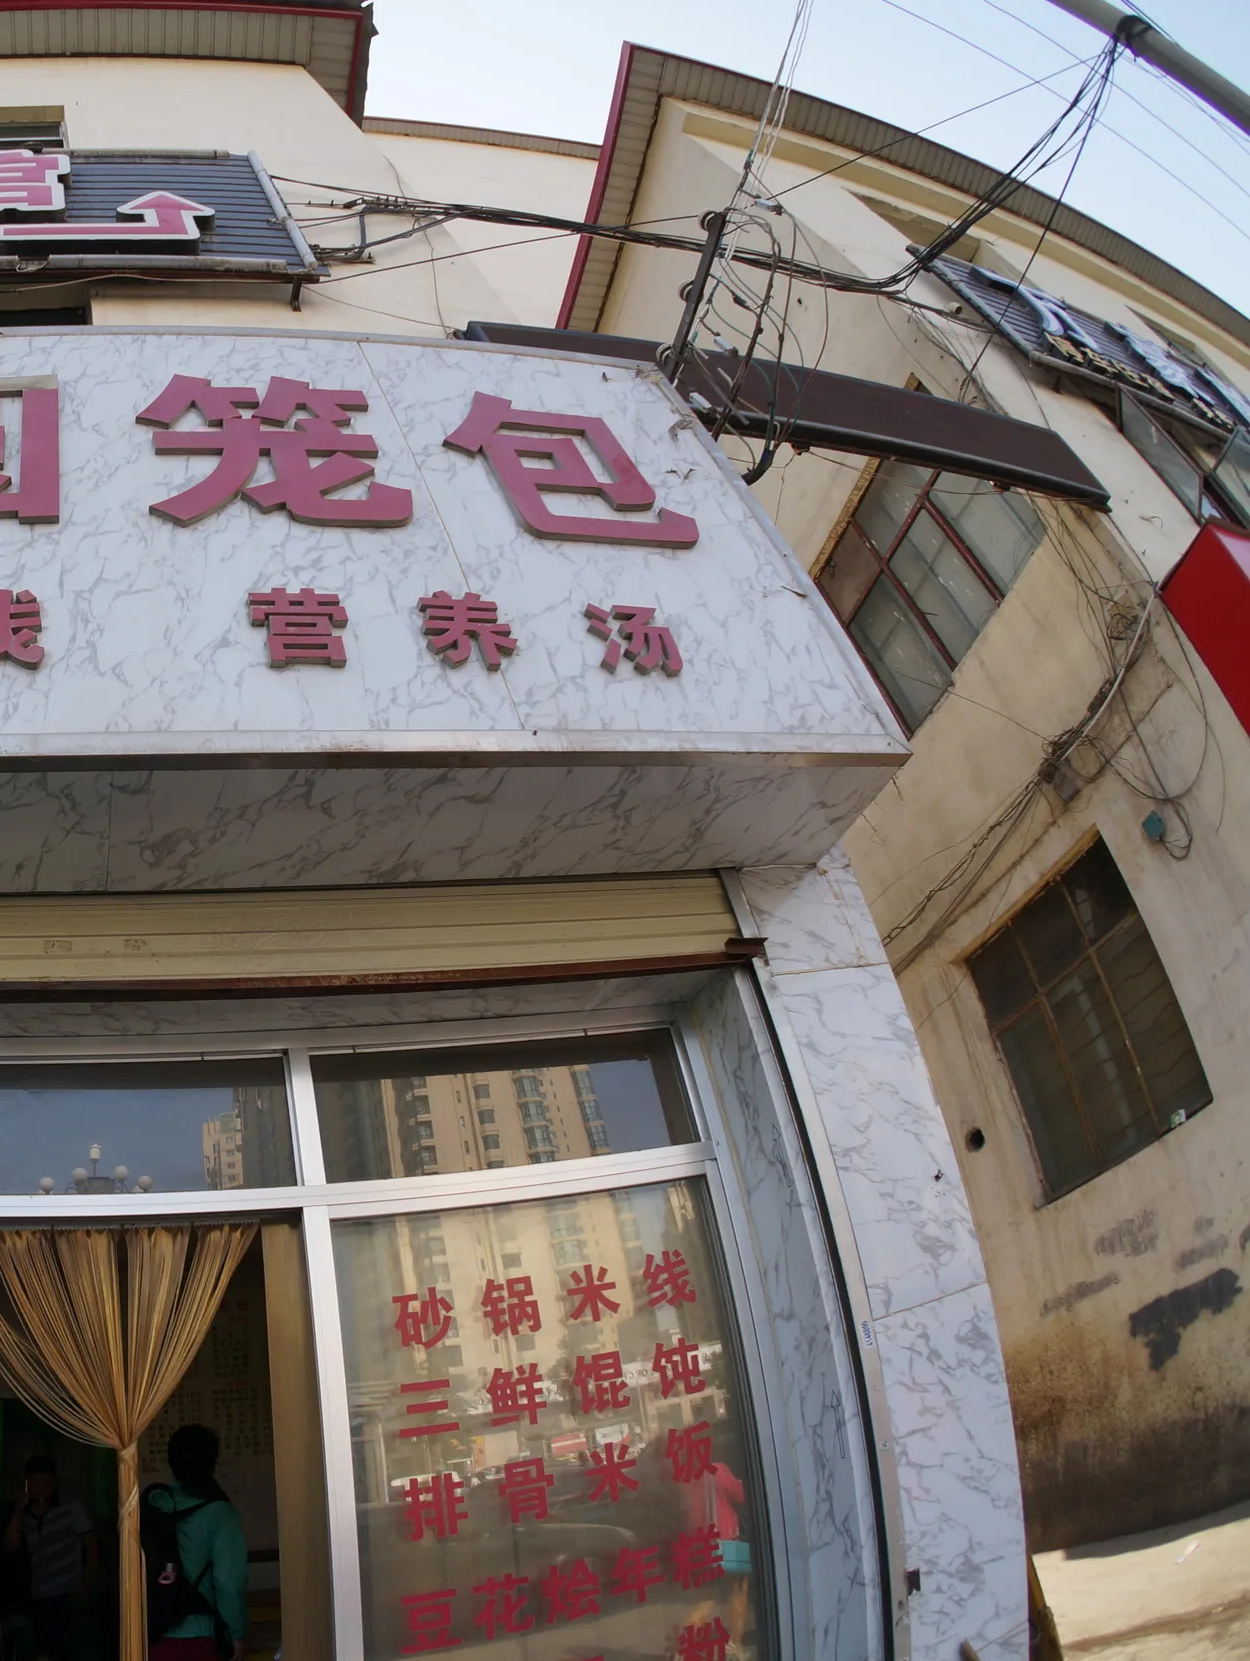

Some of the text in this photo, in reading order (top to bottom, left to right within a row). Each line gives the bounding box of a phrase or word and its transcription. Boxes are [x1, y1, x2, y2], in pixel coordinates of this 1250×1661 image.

[247, 588, 684, 677] 营养汤
[392, 1249, 697, 1349] 砂锅米线
[399, 1338, 707, 1438] 三鲜馄饨
[403, 1420, 718, 1541] 排骨米饭
[400, 1523, 725, 1654] 豆花烩年糕
